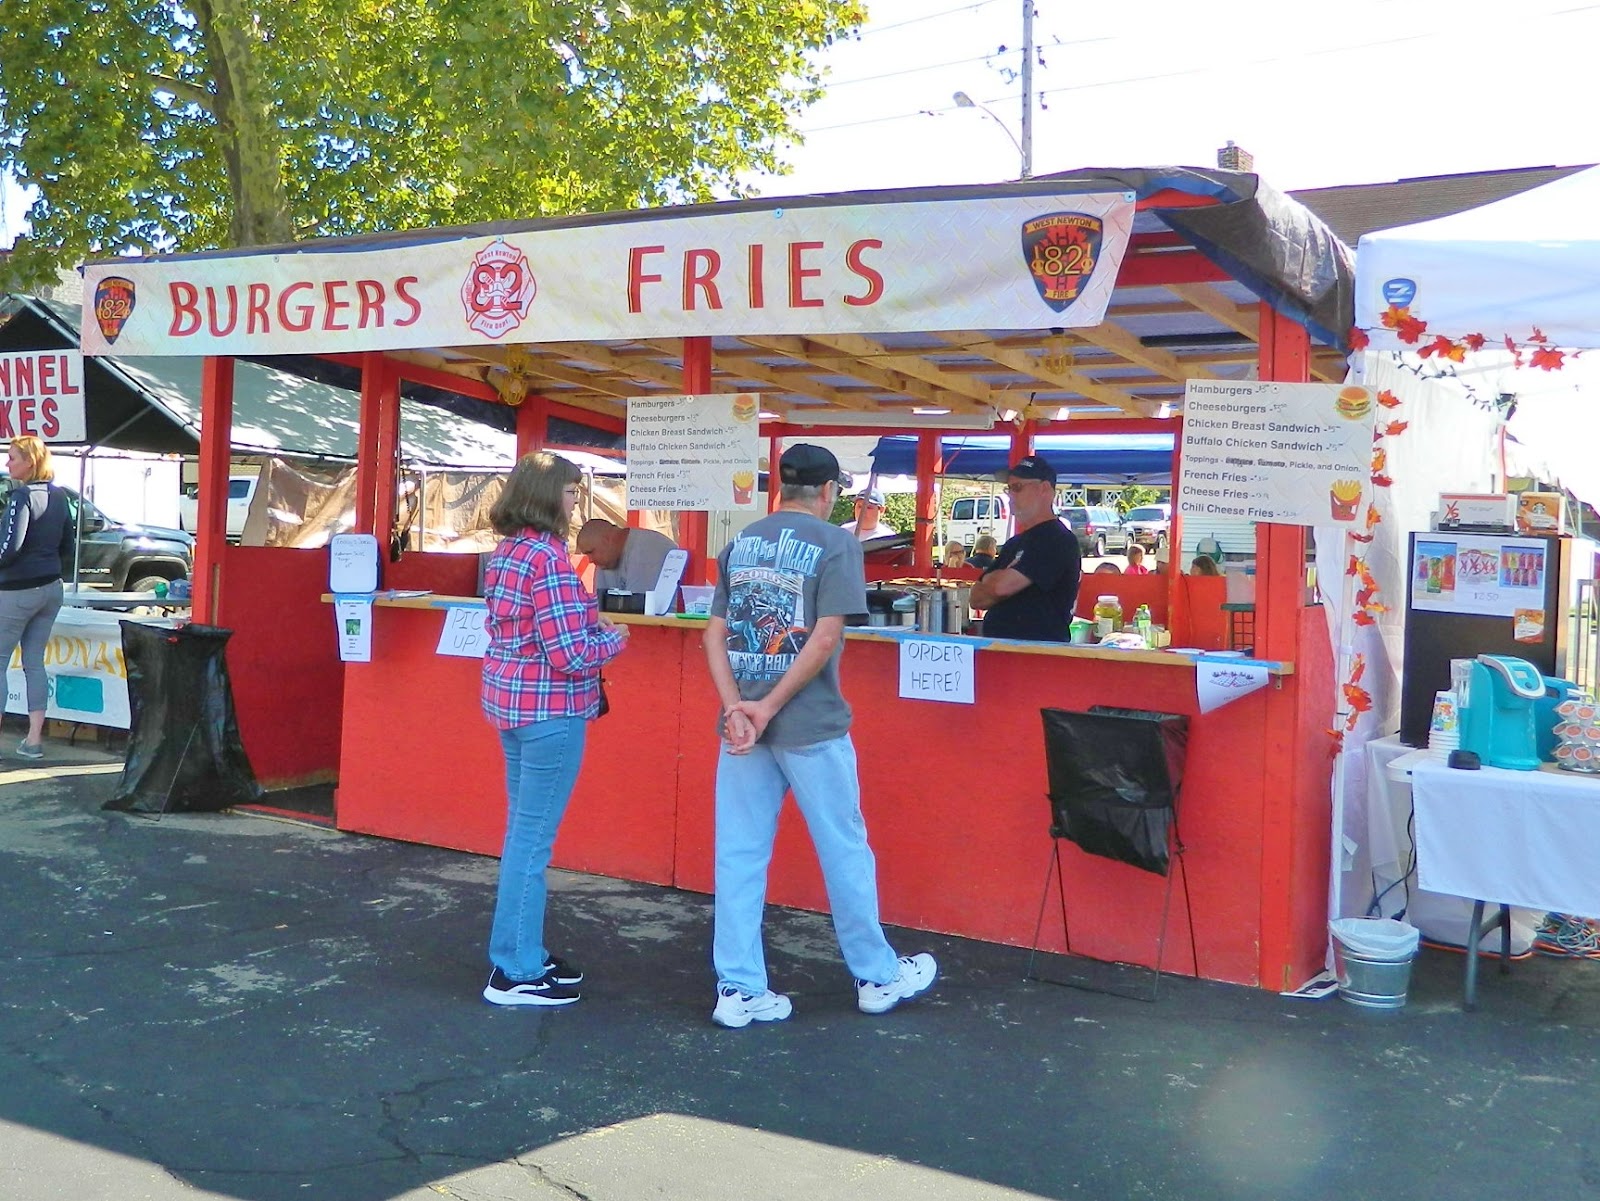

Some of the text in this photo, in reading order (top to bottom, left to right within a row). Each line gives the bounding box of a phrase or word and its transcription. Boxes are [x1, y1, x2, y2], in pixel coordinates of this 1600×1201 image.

[1032, 216, 1092, 229] WEST NEWTON
[1043, 245, 1083, 276] 82
[627, 239, 885, 313] FRIES
[471, 263, 523, 312] 82
[1052, 290, 1069, 298] FIRE
[168, 275, 422, 337] BURGERS
[1189, 384, 1253, 396] Hamburgers
[631, 401, 675, 410] Hamburgers
[1188, 402, 1266, 414] Cheeseburgers
[630, 414, 686, 423] Cheeseburgers
[630, 429, 660, 437] Chicken
[687, 428, 724, 436] Sandwich
[1187, 419, 1229, 430] Chicken
[1231, 421, 1265, 431] Breast
[1268, 422, 1321, 434] Sandwich
[630, 443, 657, 451] Buffalo
[658, 443, 688, 451] Chicken
[689, 442, 726, 450] Sandwich
[1186, 436, 1223, 447] Buffalo
[1226, 438, 1268, 449] Chicken
[1270, 440, 1323, 452] Sandwich
[1185, 455, 1219, 465] Toppings
[1289, 461, 1315, 470] Pickle,
[1317, 463, 1333, 471] and
[1334, 464, 1361, 473] Onion.
[630, 471, 655, 479] French
[656, 471, 675, 479] Fries
[1184, 470, 1219, 481] French
[1221, 472, 1247, 482] Fries
[629, 485, 657, 493] Cheese
[658, 485, 677, 493] Fries
[1182, 486, 1220, 497] Cheese
[1223, 489, 1249, 499] Fries
[647, 499, 675, 507] Cheese
[676, 499, 695, 507] Fries
[1181, 502, 1204, 513] Chili
[1207, 504, 1245, 516] Cheese
[1248, 507, 1274, 518] Fries
[775, 528, 823, 577] VALLEY
[452, 609, 487, 630] PIC
[454, 634, 482, 652] UP!
[908, 644, 963, 664] ORDER
